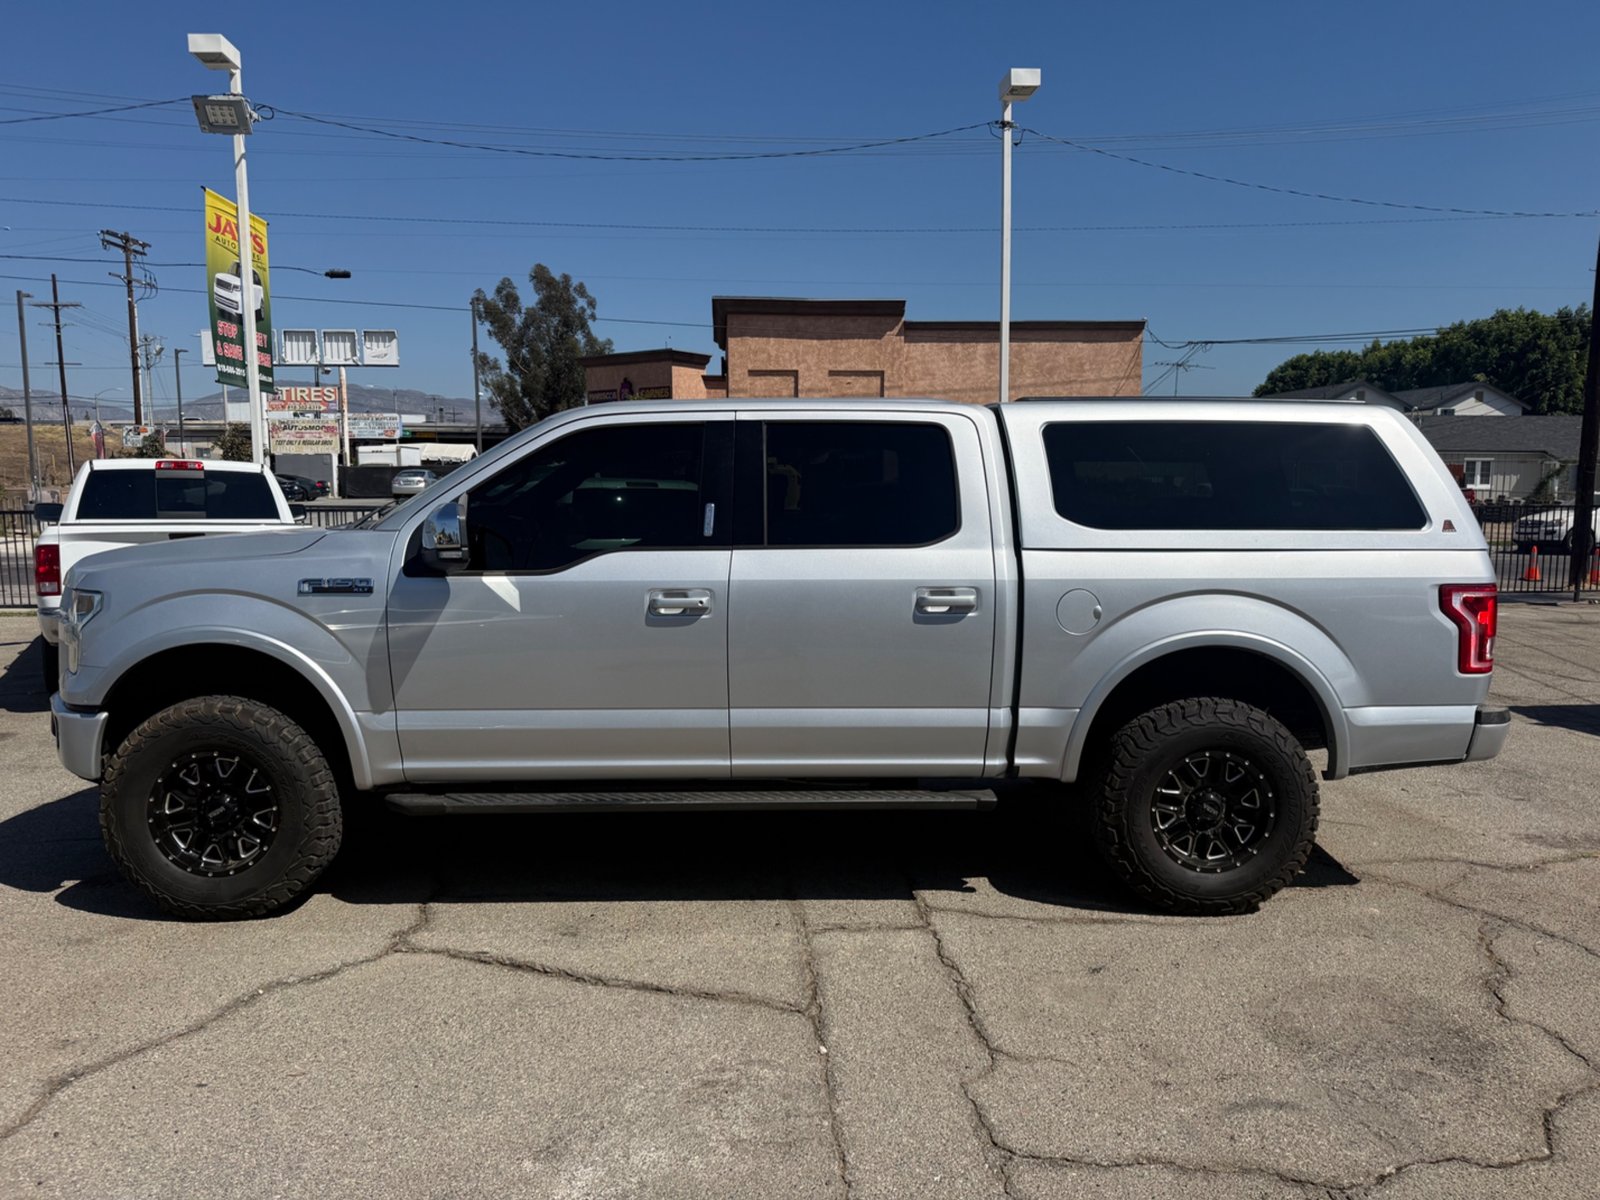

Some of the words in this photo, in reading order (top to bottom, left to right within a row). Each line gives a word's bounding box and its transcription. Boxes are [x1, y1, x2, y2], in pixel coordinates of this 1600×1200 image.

[215, 235, 237, 250] AUTO
[217, 320, 238, 339] STOP
[280, 387, 336, 402] TIRES
